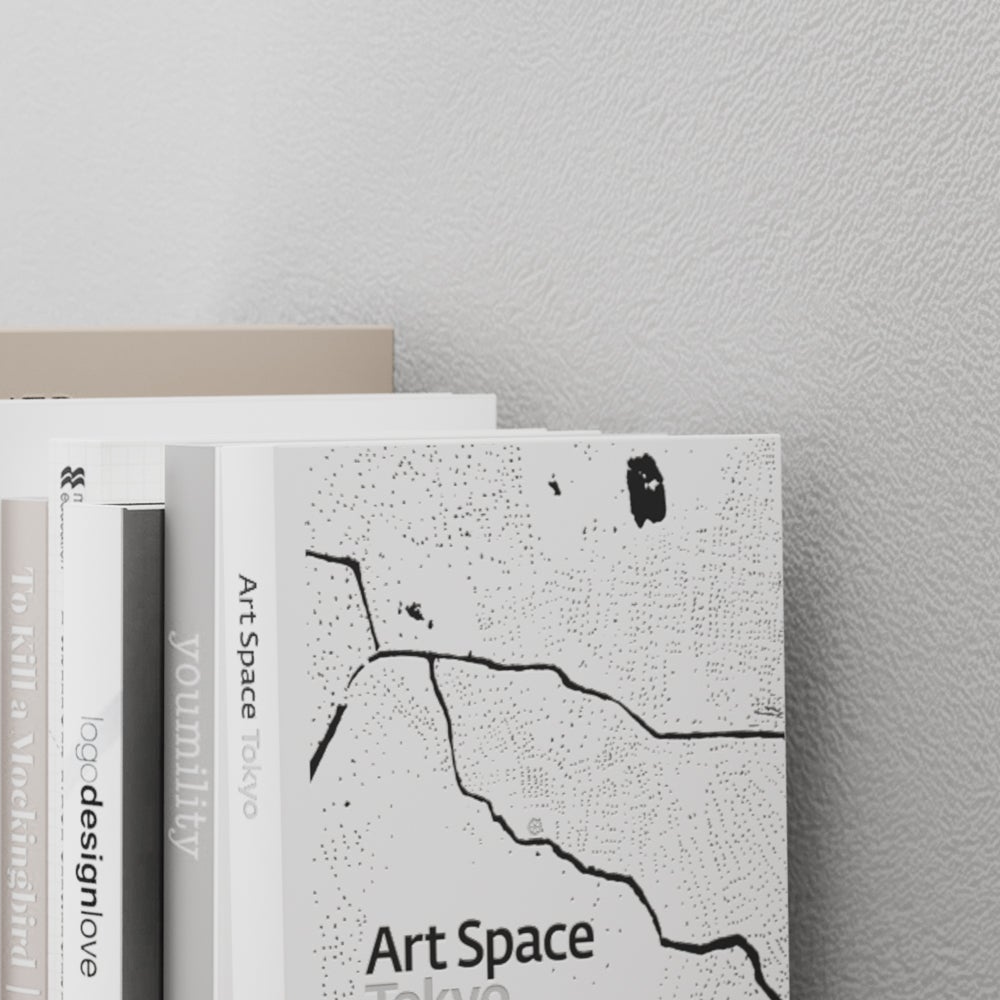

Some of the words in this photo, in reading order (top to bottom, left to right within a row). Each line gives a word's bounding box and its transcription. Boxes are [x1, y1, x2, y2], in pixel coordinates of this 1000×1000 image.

[11, 566, 36, 615] To
[238, 573, 259, 625] Art
[11, 624, 38, 692] Kill
[236, 631, 260, 720] Space
[168, 630, 210, 861] youmility
[237, 729, 263, 820] Tokyo
[6, 733, 38, 969] Mockingbird
[365, 926, 447, 974] Art
[456, 918, 596, 981] Space
